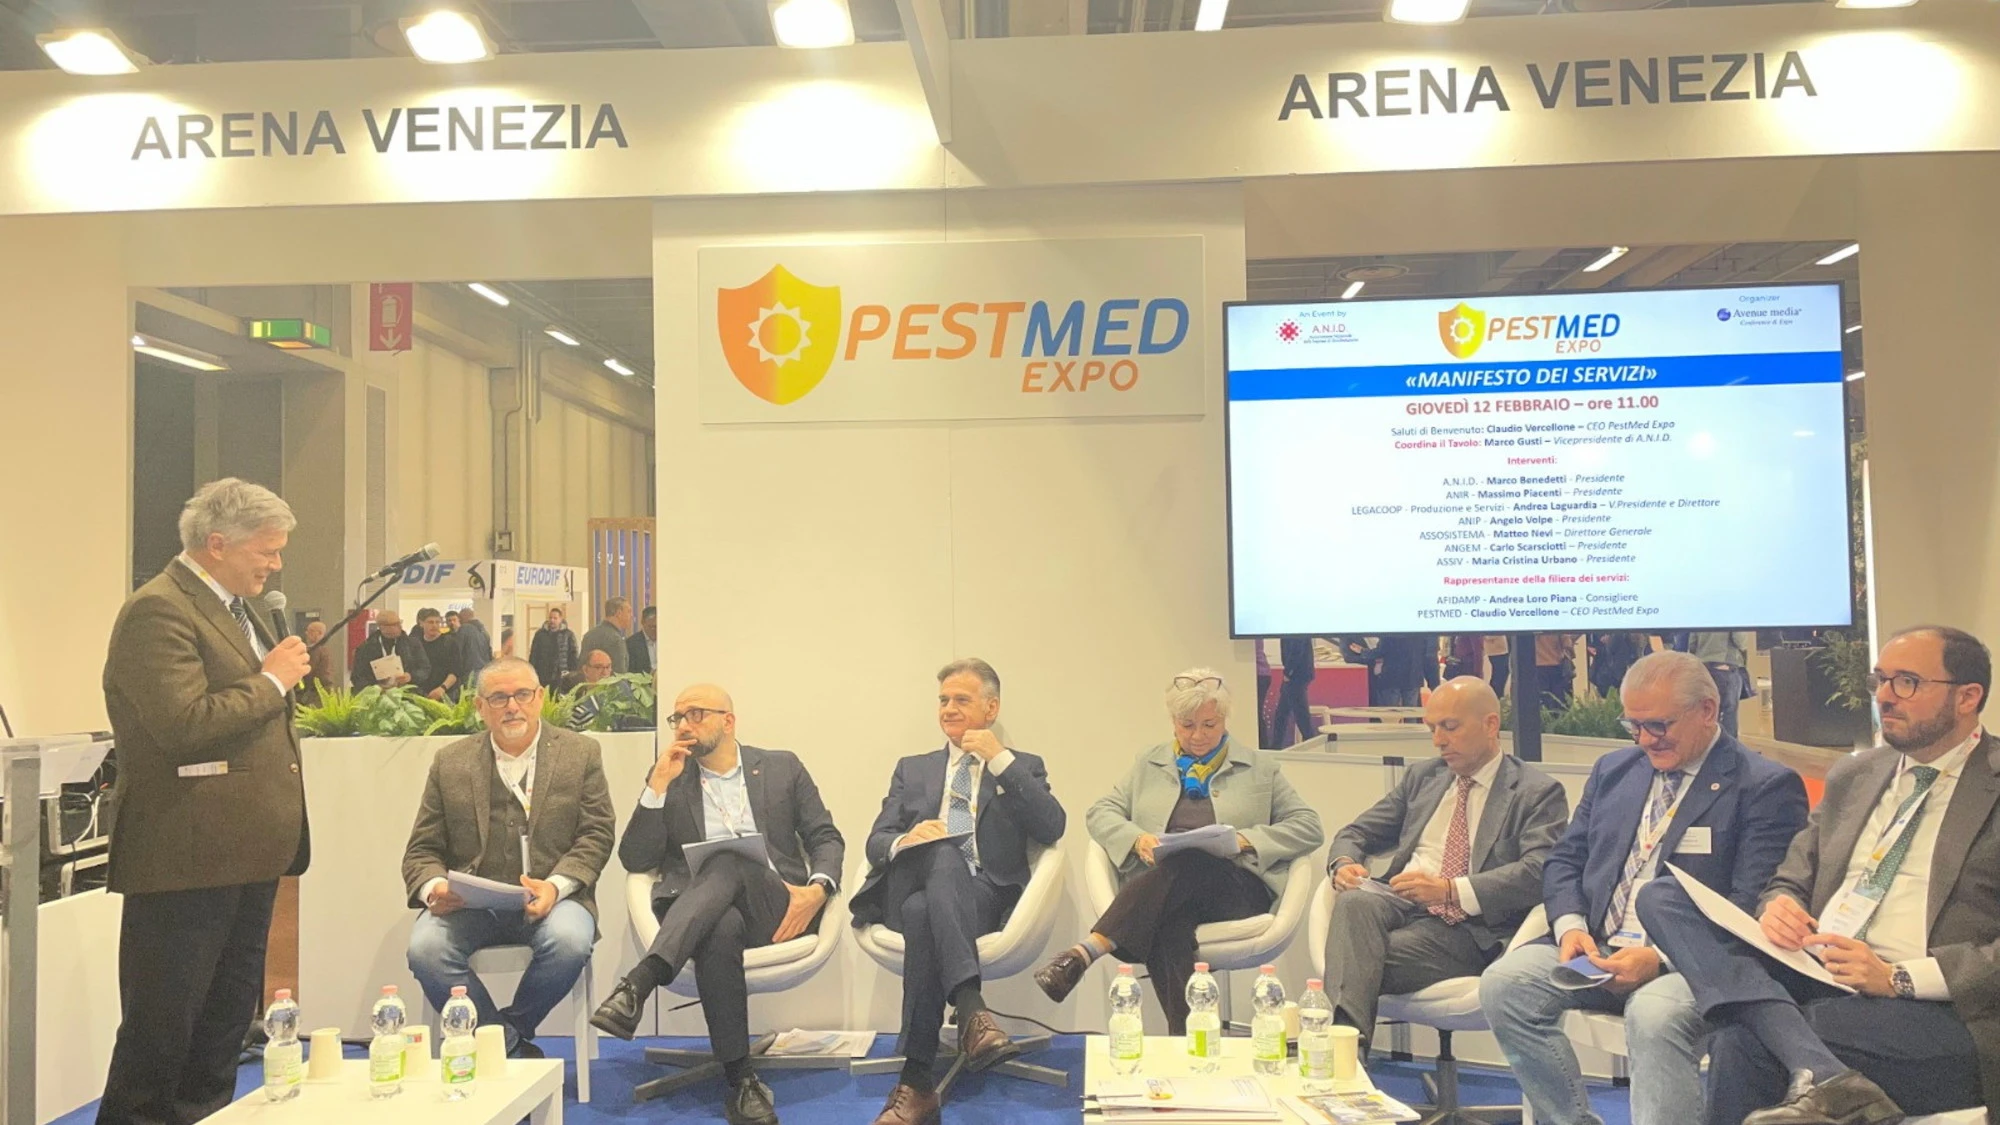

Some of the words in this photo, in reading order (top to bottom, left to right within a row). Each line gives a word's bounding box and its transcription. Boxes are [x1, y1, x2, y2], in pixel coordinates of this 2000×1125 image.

[1277, 66, 1510, 121] ARENA
[1526, 51, 1818, 109] VENEZIA
[132, 110, 346, 161] ARENA
[362, 104, 628, 153] VENEZIA
[1733, 309, 1768, 318] Avenue
[844, 298, 1190, 361] PESTMED
[1488, 314, 1620, 341] PESTMED
[1556, 340, 1602, 354] EXPO
[1021, 360, 1139, 392] EXPO
[1405, 368, 1531, 388] «MANIFESTO
[1536, 367, 1570, 384] DEI
[1572, 365, 1657, 383] SERVIZI»
[1406, 397, 1470, 416] GIOVEDÌ
[1474, 400, 1491, 413] 12
[1496, 398, 1571, 412] FEBBRAIO
[1588, 399, 1613, 410] ore
[1617, 395, 1659, 409] 11.00
[1391, 427, 1418, 436] Saluti
[1419, 426, 1429, 436] di
[1430, 426, 1485, 435] Benvenuto:
[1486, 424, 1524, 434] Claudio
[1524, 423, 1576, 432] Vercellone
[1586, 421, 1606, 431] CEO
[1608, 420, 1650, 430] PestMed
[1652, 420, 1676, 431] Expo
[1395, 440, 1438, 449] Coordina
[1439, 439, 1446, 448] il
[1448, 439, 1482, 448] Tavolo:
[1484, 438, 1516, 446] Marco
[1517, 437, 1544, 446] Gusti
[1553, 435, 1623, 445] Vicepresidente
[1625, 434, 1635, 443] di
[1636, 433, 1672, 442] A.N.I.D.
[1507, 456, 1558, 465] Interventi:
[1443, 477, 1479, 486] A.N.I.D.
[1486, 476, 1518, 485] Marco
[1519, 475, 1568, 484] Benedetti
[1575, 474, 1626, 483] Presidente
[1446, 490, 1470, 499] ANIR
[1477, 490, 1522, 498] Massimo
[1523, 489, 1563, 498] Piacenti
[1573, 487, 1623, 497] Presidente
[1352, 505, 1403, 516] LEGACOOP
[1411, 505, 1464, 513] Produzione
[1474, 504, 1505, 512] Servizi
[1513, 502, 1549, 511] Andrea
[1550, 501, 1598, 512] Laguardia
[1608, 500, 1667, 509] V.Presidente
[1677, 498, 1721, 508] Direttore
[1458, 516, 1482, 525] ANIP
[1489, 516, 1524, 526] Angelo
[1525, 515, 1554, 525] Volpe
[1562, 514, 1612, 523] Presidente
[1420, 530, 1486, 540] ASSOSISTEMA
[1493, 530, 1530, 538] Matteo
[1531, 529, 1554, 538] Nevi
[1564, 528, 1607, 537] Direttore
[1609, 527, 1653, 536] Generale
[1445, 544, 1481, 553] ANGEM
[1490, 543, 1516, 552] Carlo
[1517, 542, 1567, 551] Scarsciotti
[1577, 541, 1628, 550] Presidente
[1436, 557, 1464, 566] ASSIV
[1472, 557, 1501, 565] Maria
[1502, 556, 1540, 565] Cristina
[1541, 555, 1578, 564] Urbano
[1586, 554, 1637, 563] Presidente
[402, 563, 456, 585] DIF
[516, 566, 561, 586] EURODIF
[1443, 576, 1520, 587] Rappresentanze
[1522, 575, 1546, 584] della
[1548, 574, 1577, 583] filiera
[1578, 574, 1594, 583] dei
[1596, 574, 1630, 582] servizi:
[1437, 595, 1481, 605] AFIDAMP
[1489, 595, 1525, 604] Andrea
[1526, 595, 1549, 604] Loro
[1550, 594, 1578, 603] Piana
[1586, 593, 1639, 604] Consigliere
[1417, 609, 1463, 619] PESTMED
[1471, 608, 1507, 618] Claudio
[1507, 608, 1560, 617] Vercellone
[1570, 606, 1591, 616] CEO
[1592, 606, 1635, 615] PestMed
[1635, 606, 1660, 617] Expo
